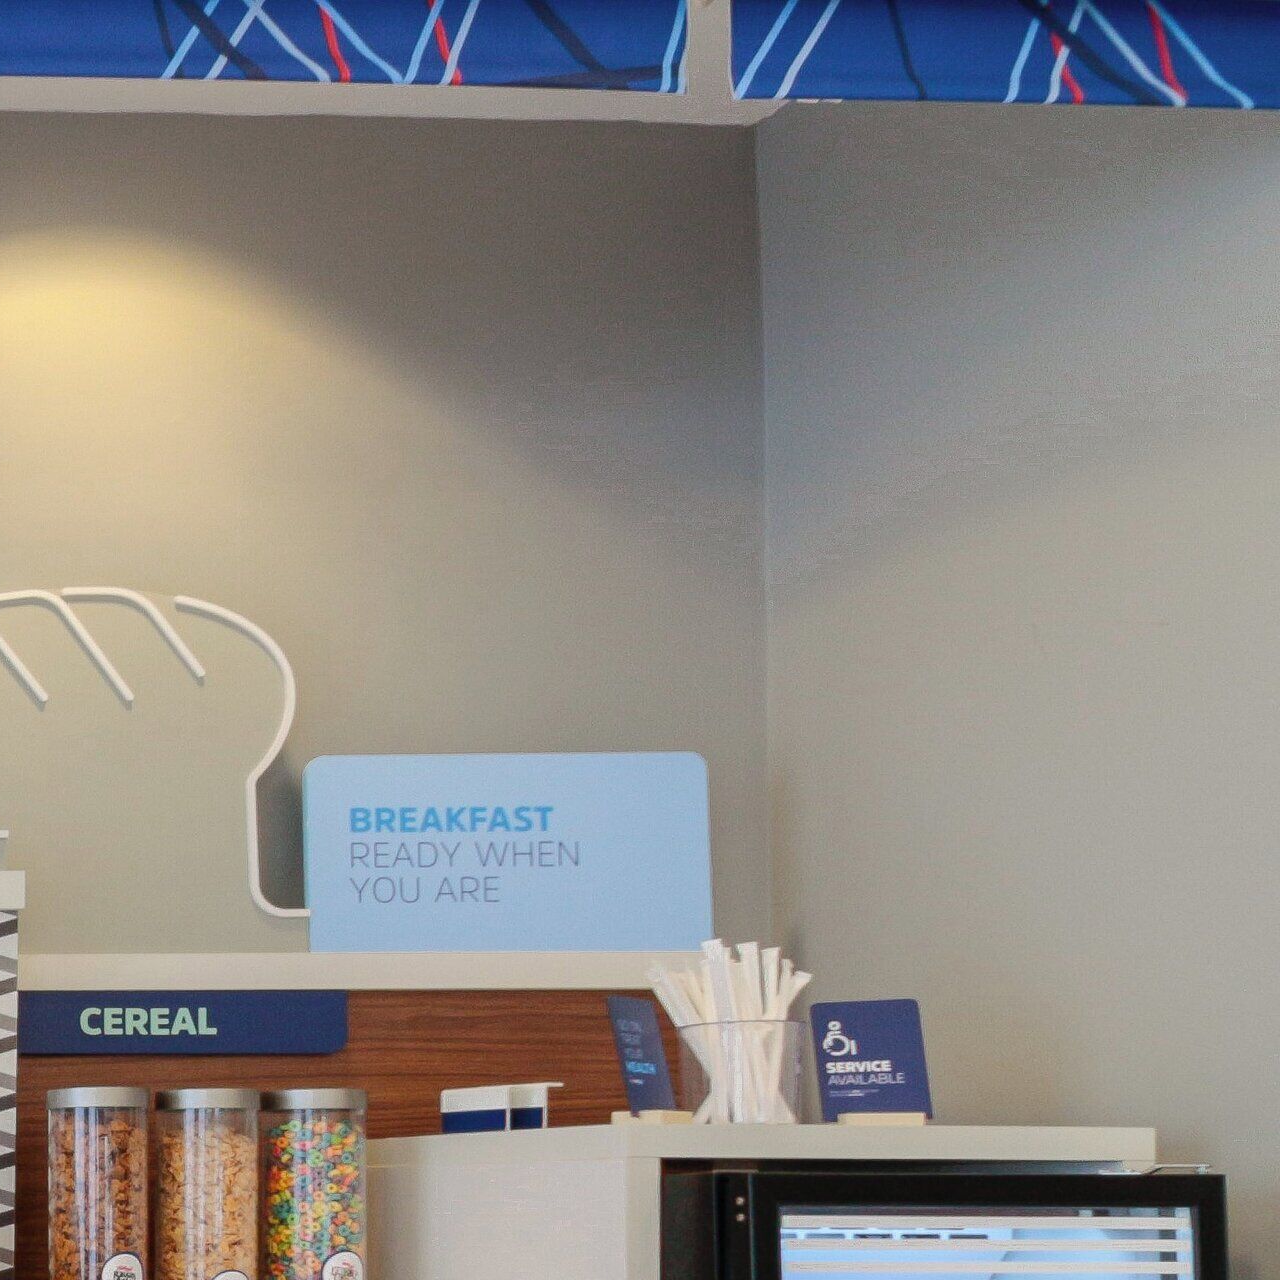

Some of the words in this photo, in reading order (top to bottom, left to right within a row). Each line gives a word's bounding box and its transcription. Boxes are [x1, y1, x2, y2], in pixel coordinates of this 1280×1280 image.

[348, 805, 555, 834] BREAKFAST
[350, 840, 462, 870] READY
[473, 839, 580, 868] WHEN
[348, 876, 422, 904] YOU
[434, 875, 501, 904] ARE
[79, 1006, 218, 1036] CEREAL
[826, 1060, 892, 1074] SERVICE
[828, 1072, 905, 1086] AVAILABLE
